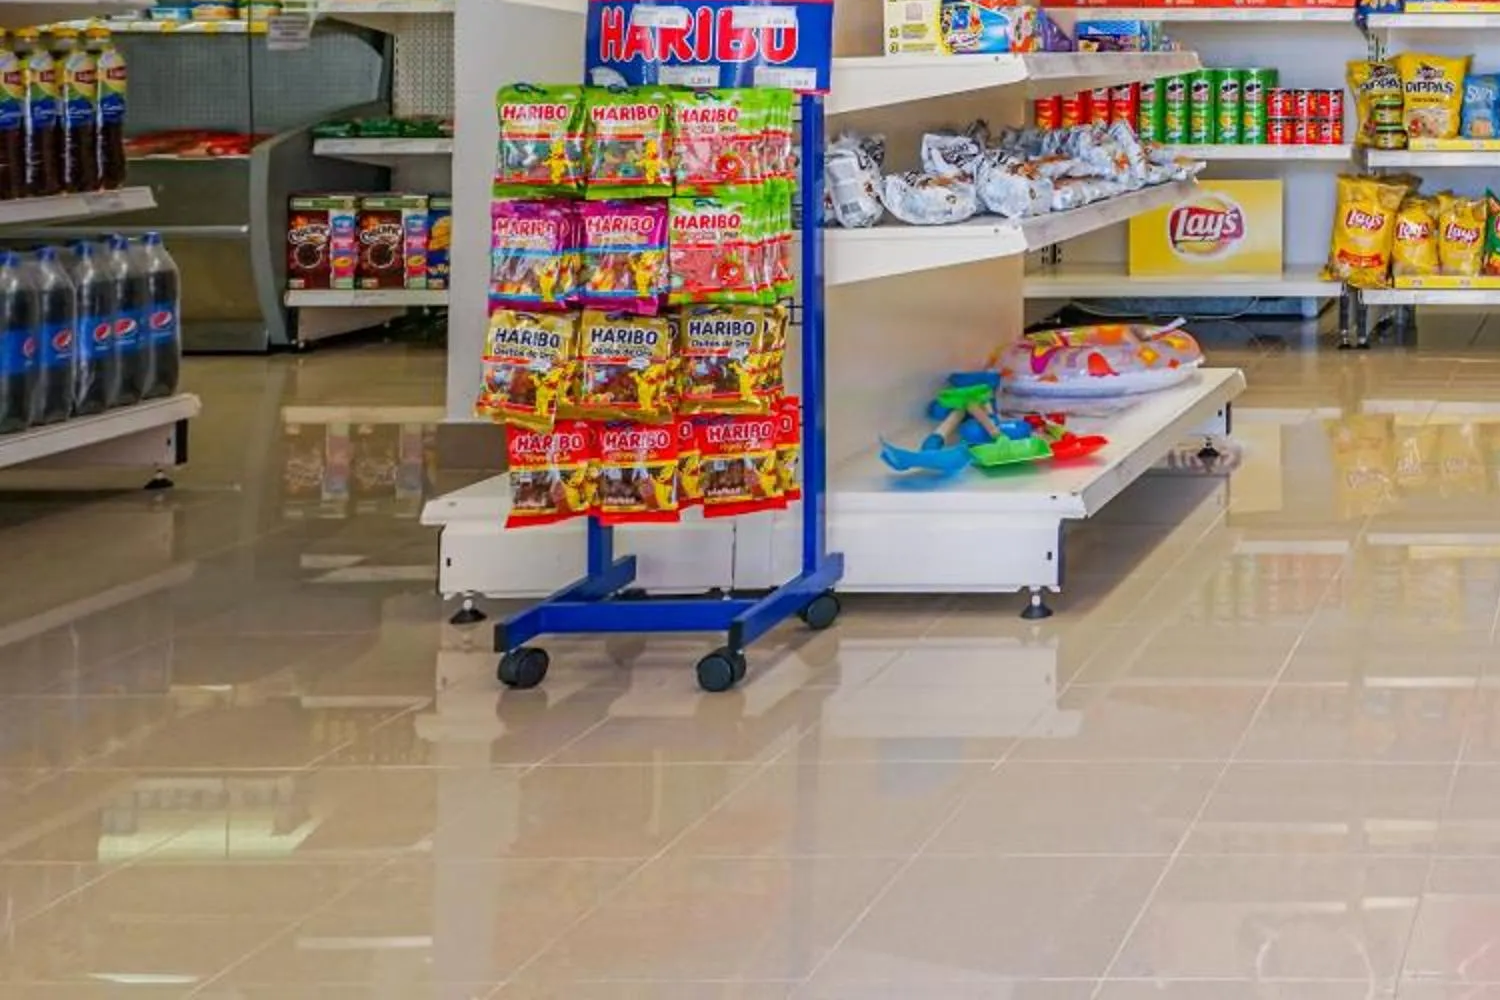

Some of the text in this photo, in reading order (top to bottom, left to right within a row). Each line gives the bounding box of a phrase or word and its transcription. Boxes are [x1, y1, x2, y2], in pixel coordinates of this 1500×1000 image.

[601, 5, 799, 63] HARIBO
[502, 103, 569, 121] HARIBO
[591, 102, 660, 121] HARIBO
[677, 105, 740, 123] HARIBO
[586, 215, 655, 233] HARIBO
[673, 213, 742, 230] HARIBO
[1173, 205, 1241, 246] Lay's
[1347, 209, 1384, 230] Lay's
[1446, 223, 1480, 243] Lay's
[494, 327, 561, 348] HARIBO
[591, 327, 659, 346] HARIBO
[689, 320, 756, 338] HARIBO
[706, 422, 774, 443] HARIBO
[516, 432, 584, 453] HARBO
